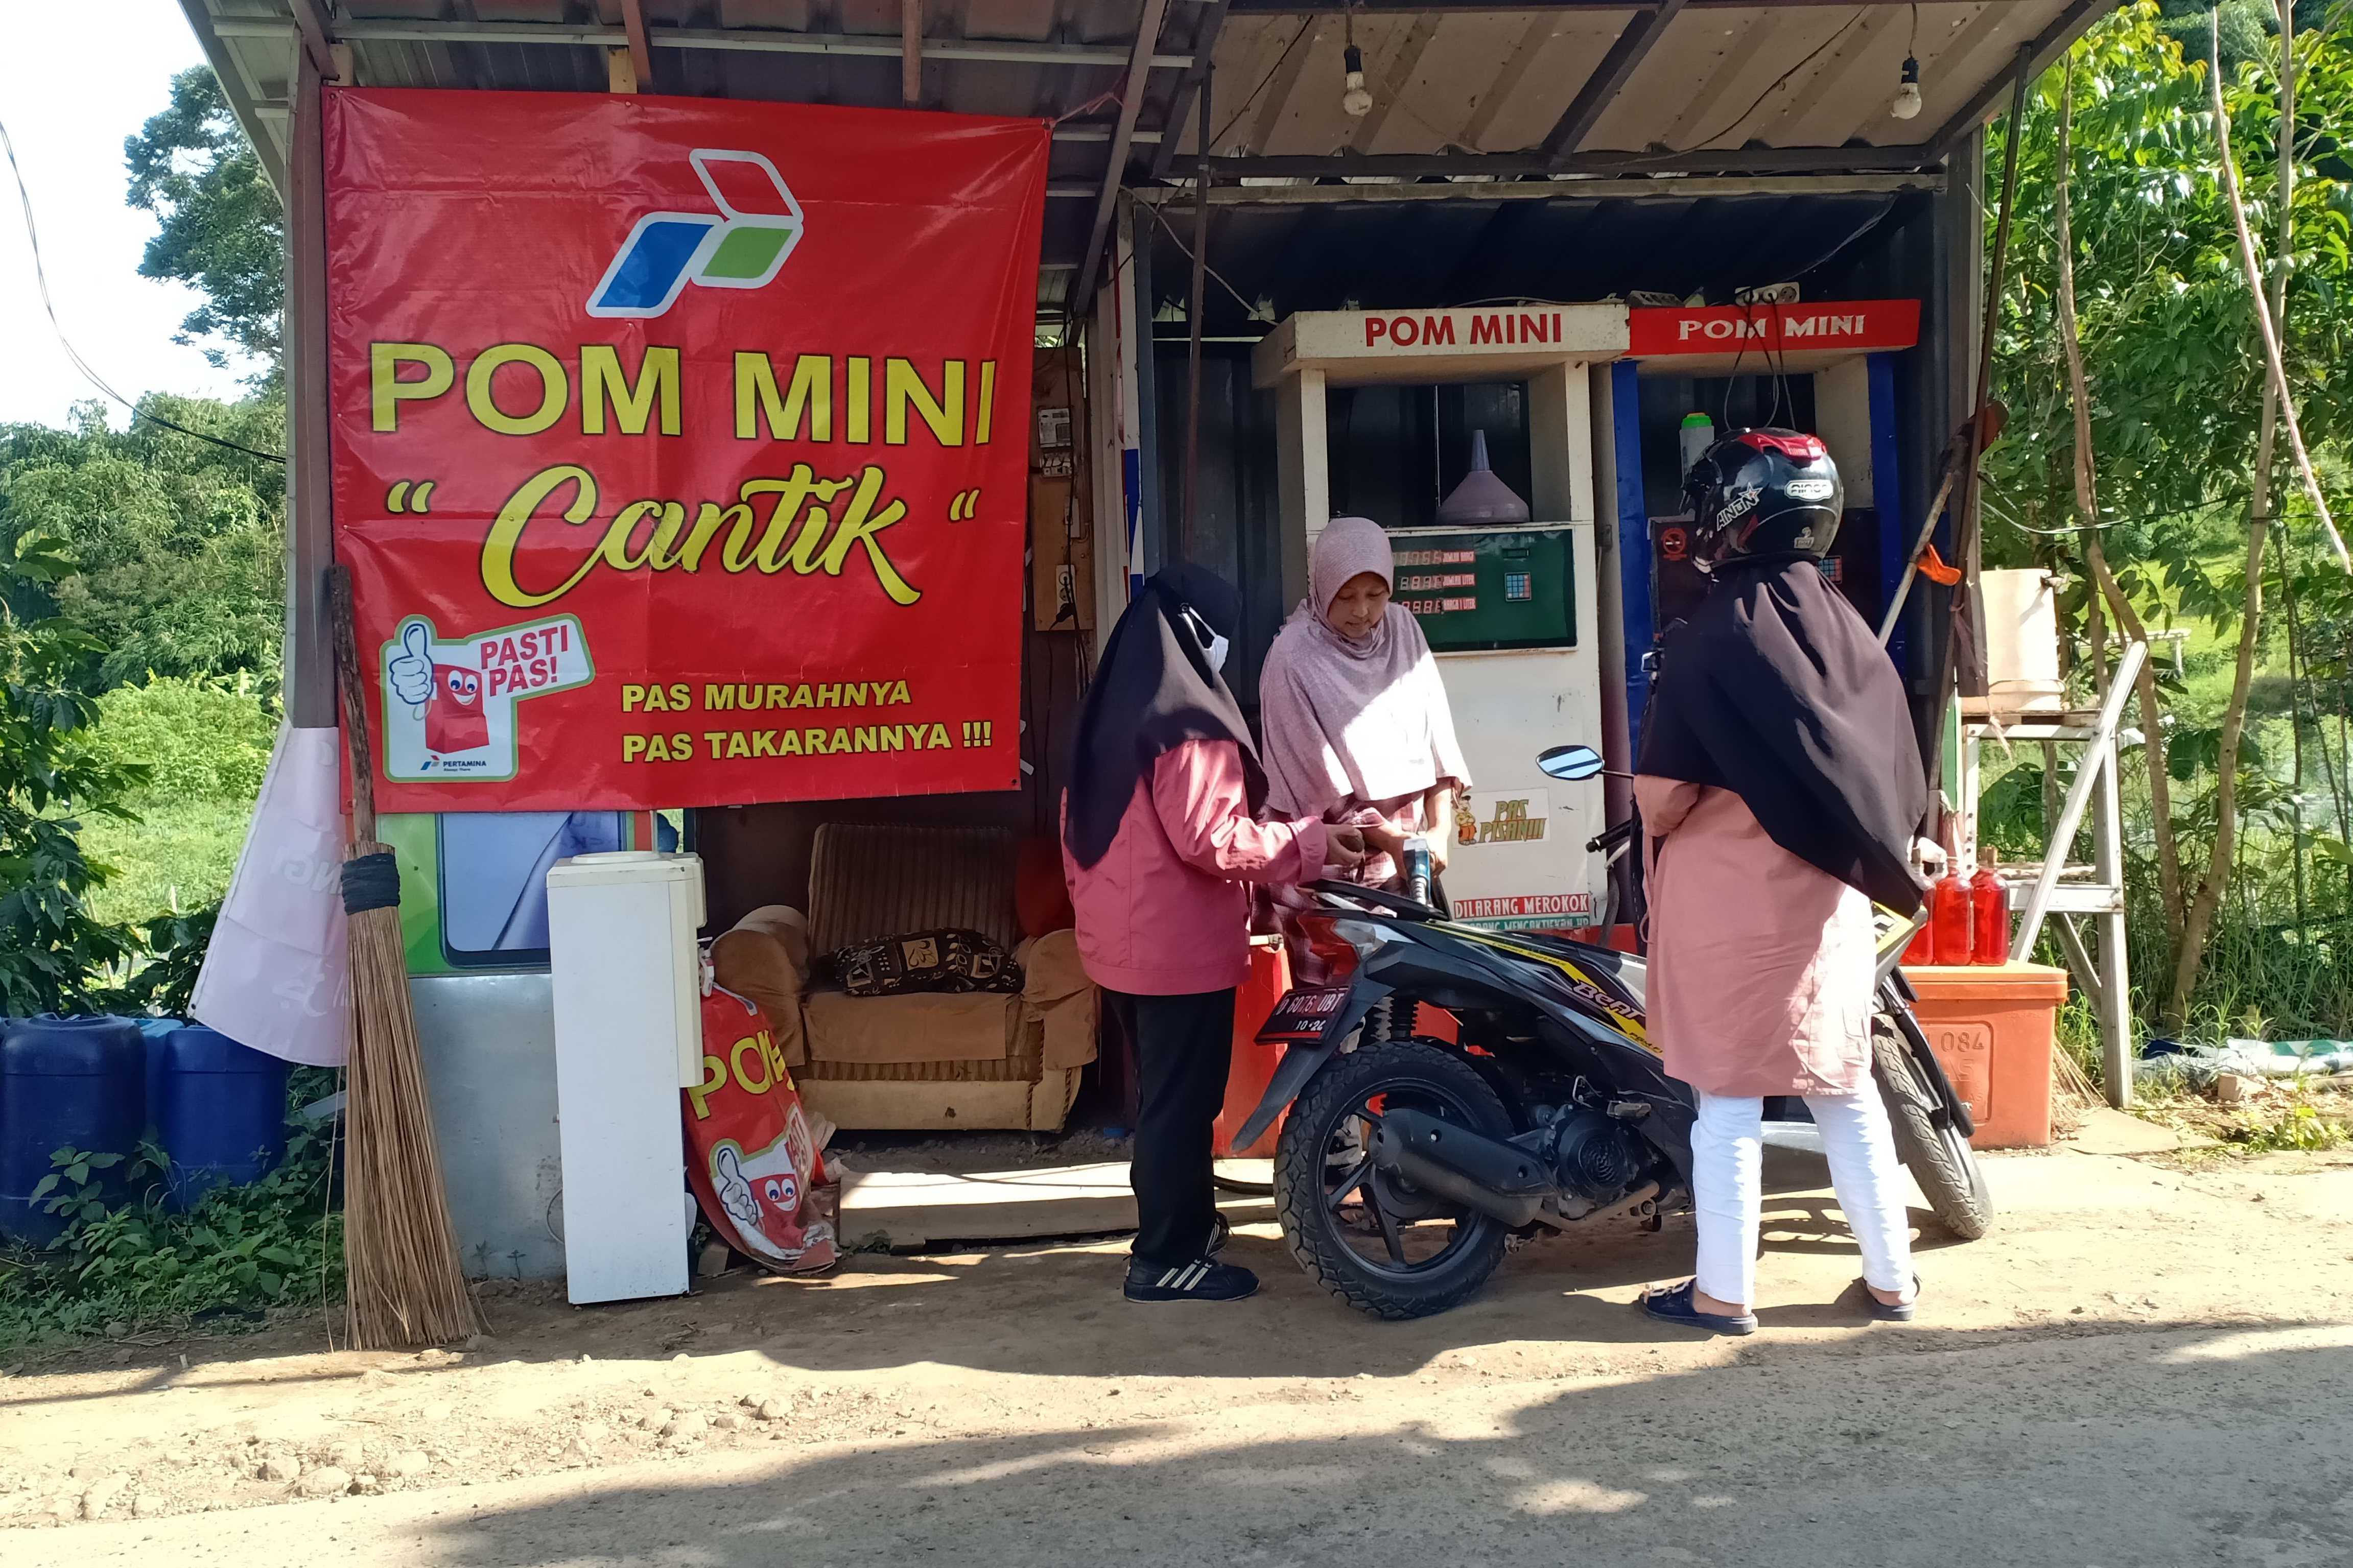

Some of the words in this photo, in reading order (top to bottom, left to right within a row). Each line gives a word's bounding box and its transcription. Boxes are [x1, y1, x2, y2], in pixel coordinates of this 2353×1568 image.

[1365, 316, 1455, 347] POM
[1470, 313, 1561, 345] MINI
[1678, 318, 1768, 340] POM
[1784, 315, 1866, 338] MINI
[369, 342, 681, 436] POM
[734, 351, 997, 446] MINI
[480, 463, 922, 607] Cantik
[480, 625, 568, 670] PASTI
[489, 656, 557, 697] PAS!
[622, 684, 691, 712] PAS
[704, 680, 912, 710] MURAHNYA
[623, 733, 694, 763] PAS
[704, 723, 952, 759] TAKARANNYA
[1494, 799, 1530, 821] PAS
[1455, 899, 1519, 918] DILARANG
[1524, 894, 1589, 916] MEROKOK
[1316, 992, 1346, 1013] UBT
